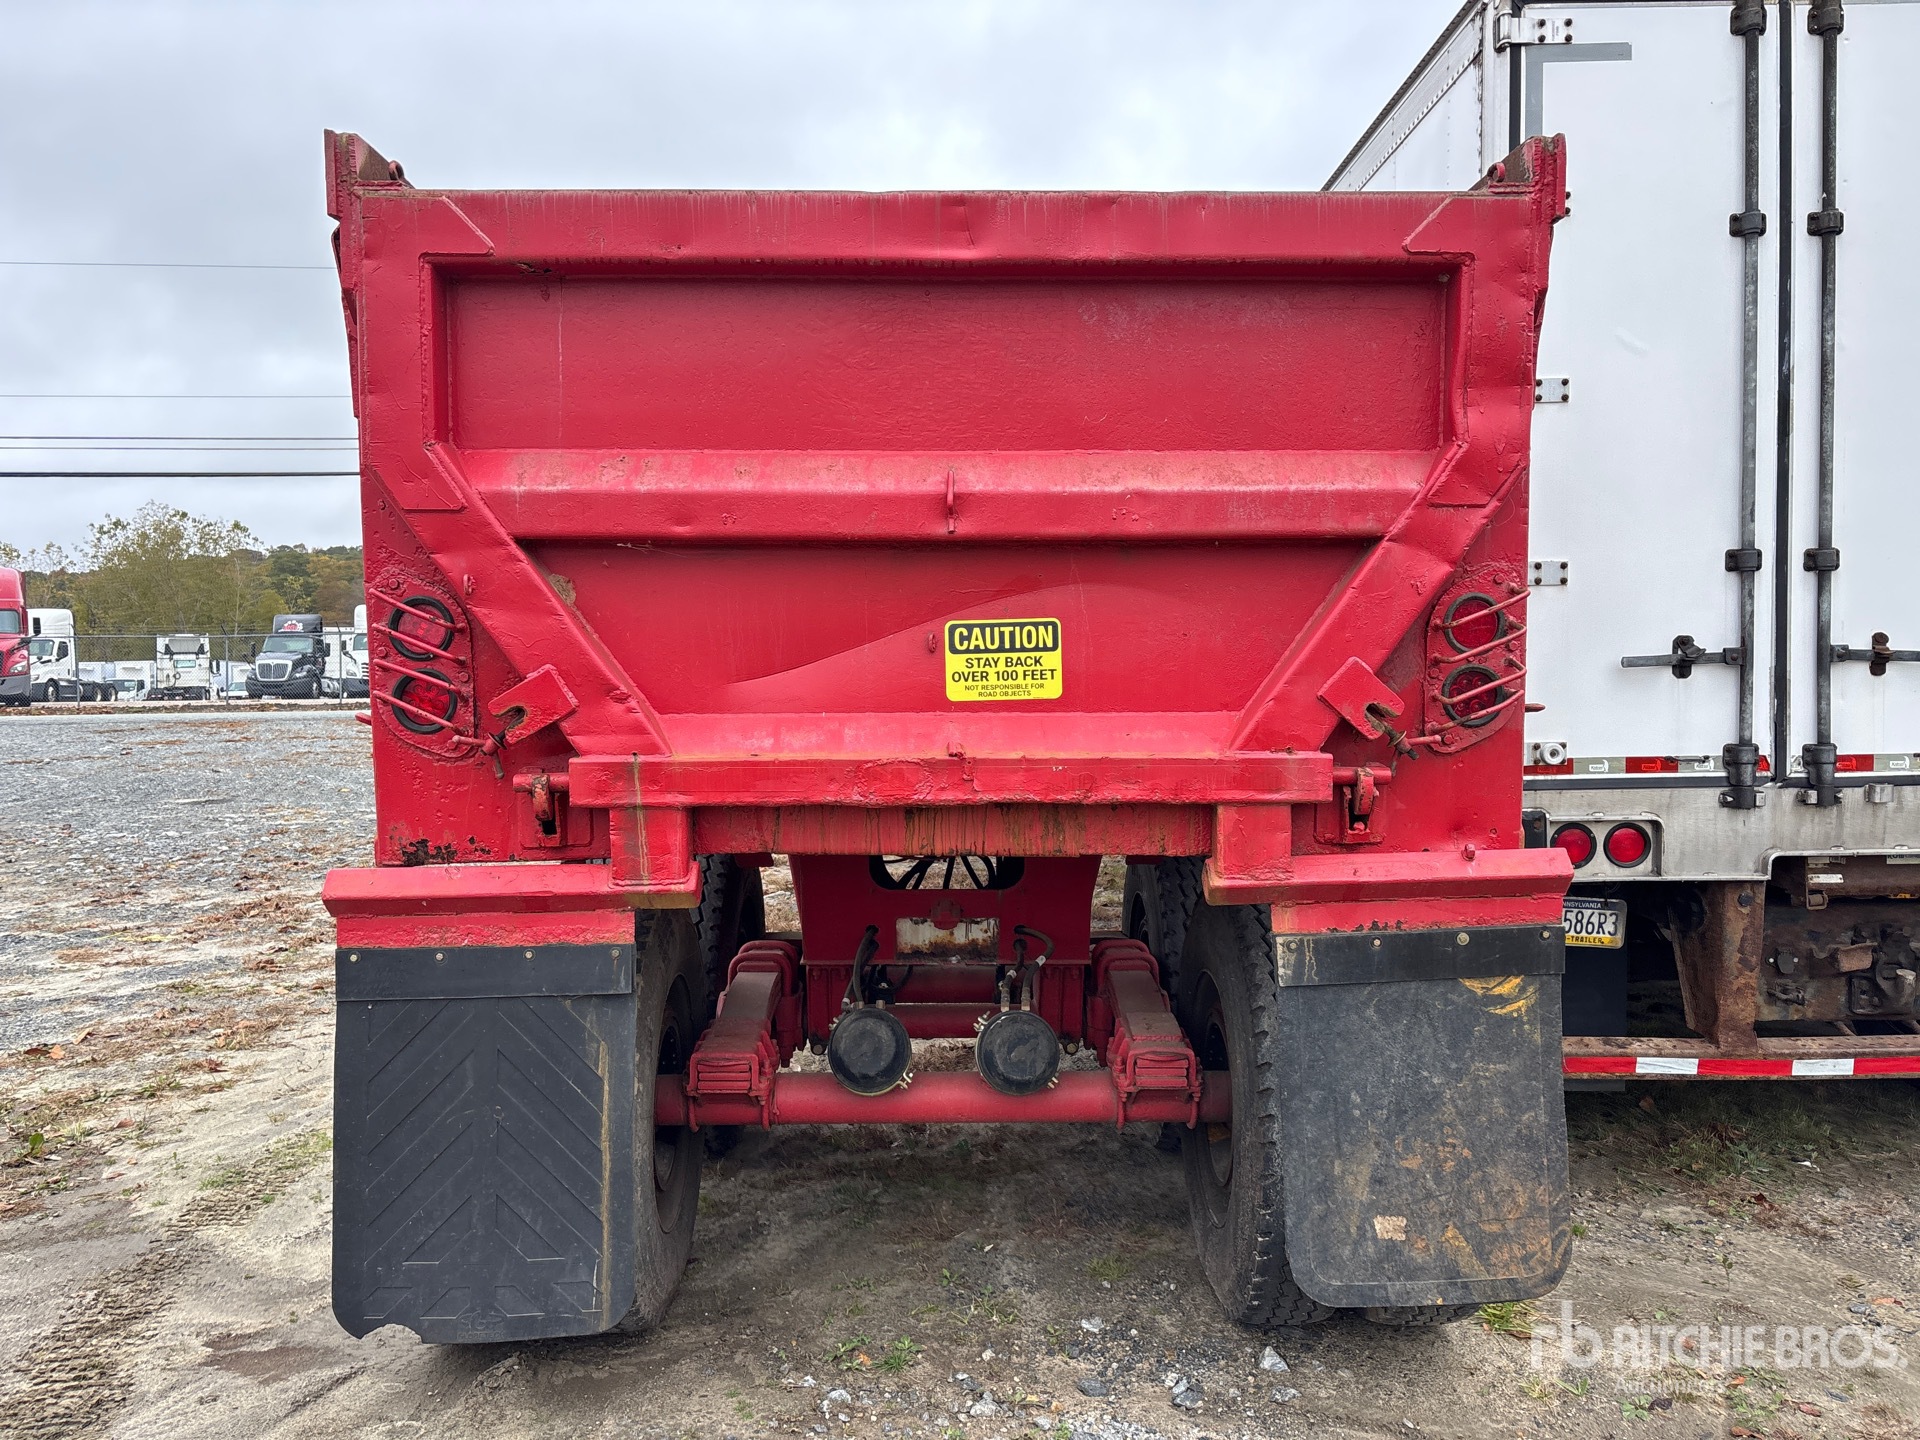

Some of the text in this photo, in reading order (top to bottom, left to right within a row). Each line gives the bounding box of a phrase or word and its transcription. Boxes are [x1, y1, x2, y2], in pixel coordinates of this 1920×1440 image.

[954, 625, 1053, 650] CAUTION
[965, 656, 1043, 668] STAY BACK
[952, 669, 1057, 682] OVER 100 FEET
[1564, 910, 1618, 936] 586R3
